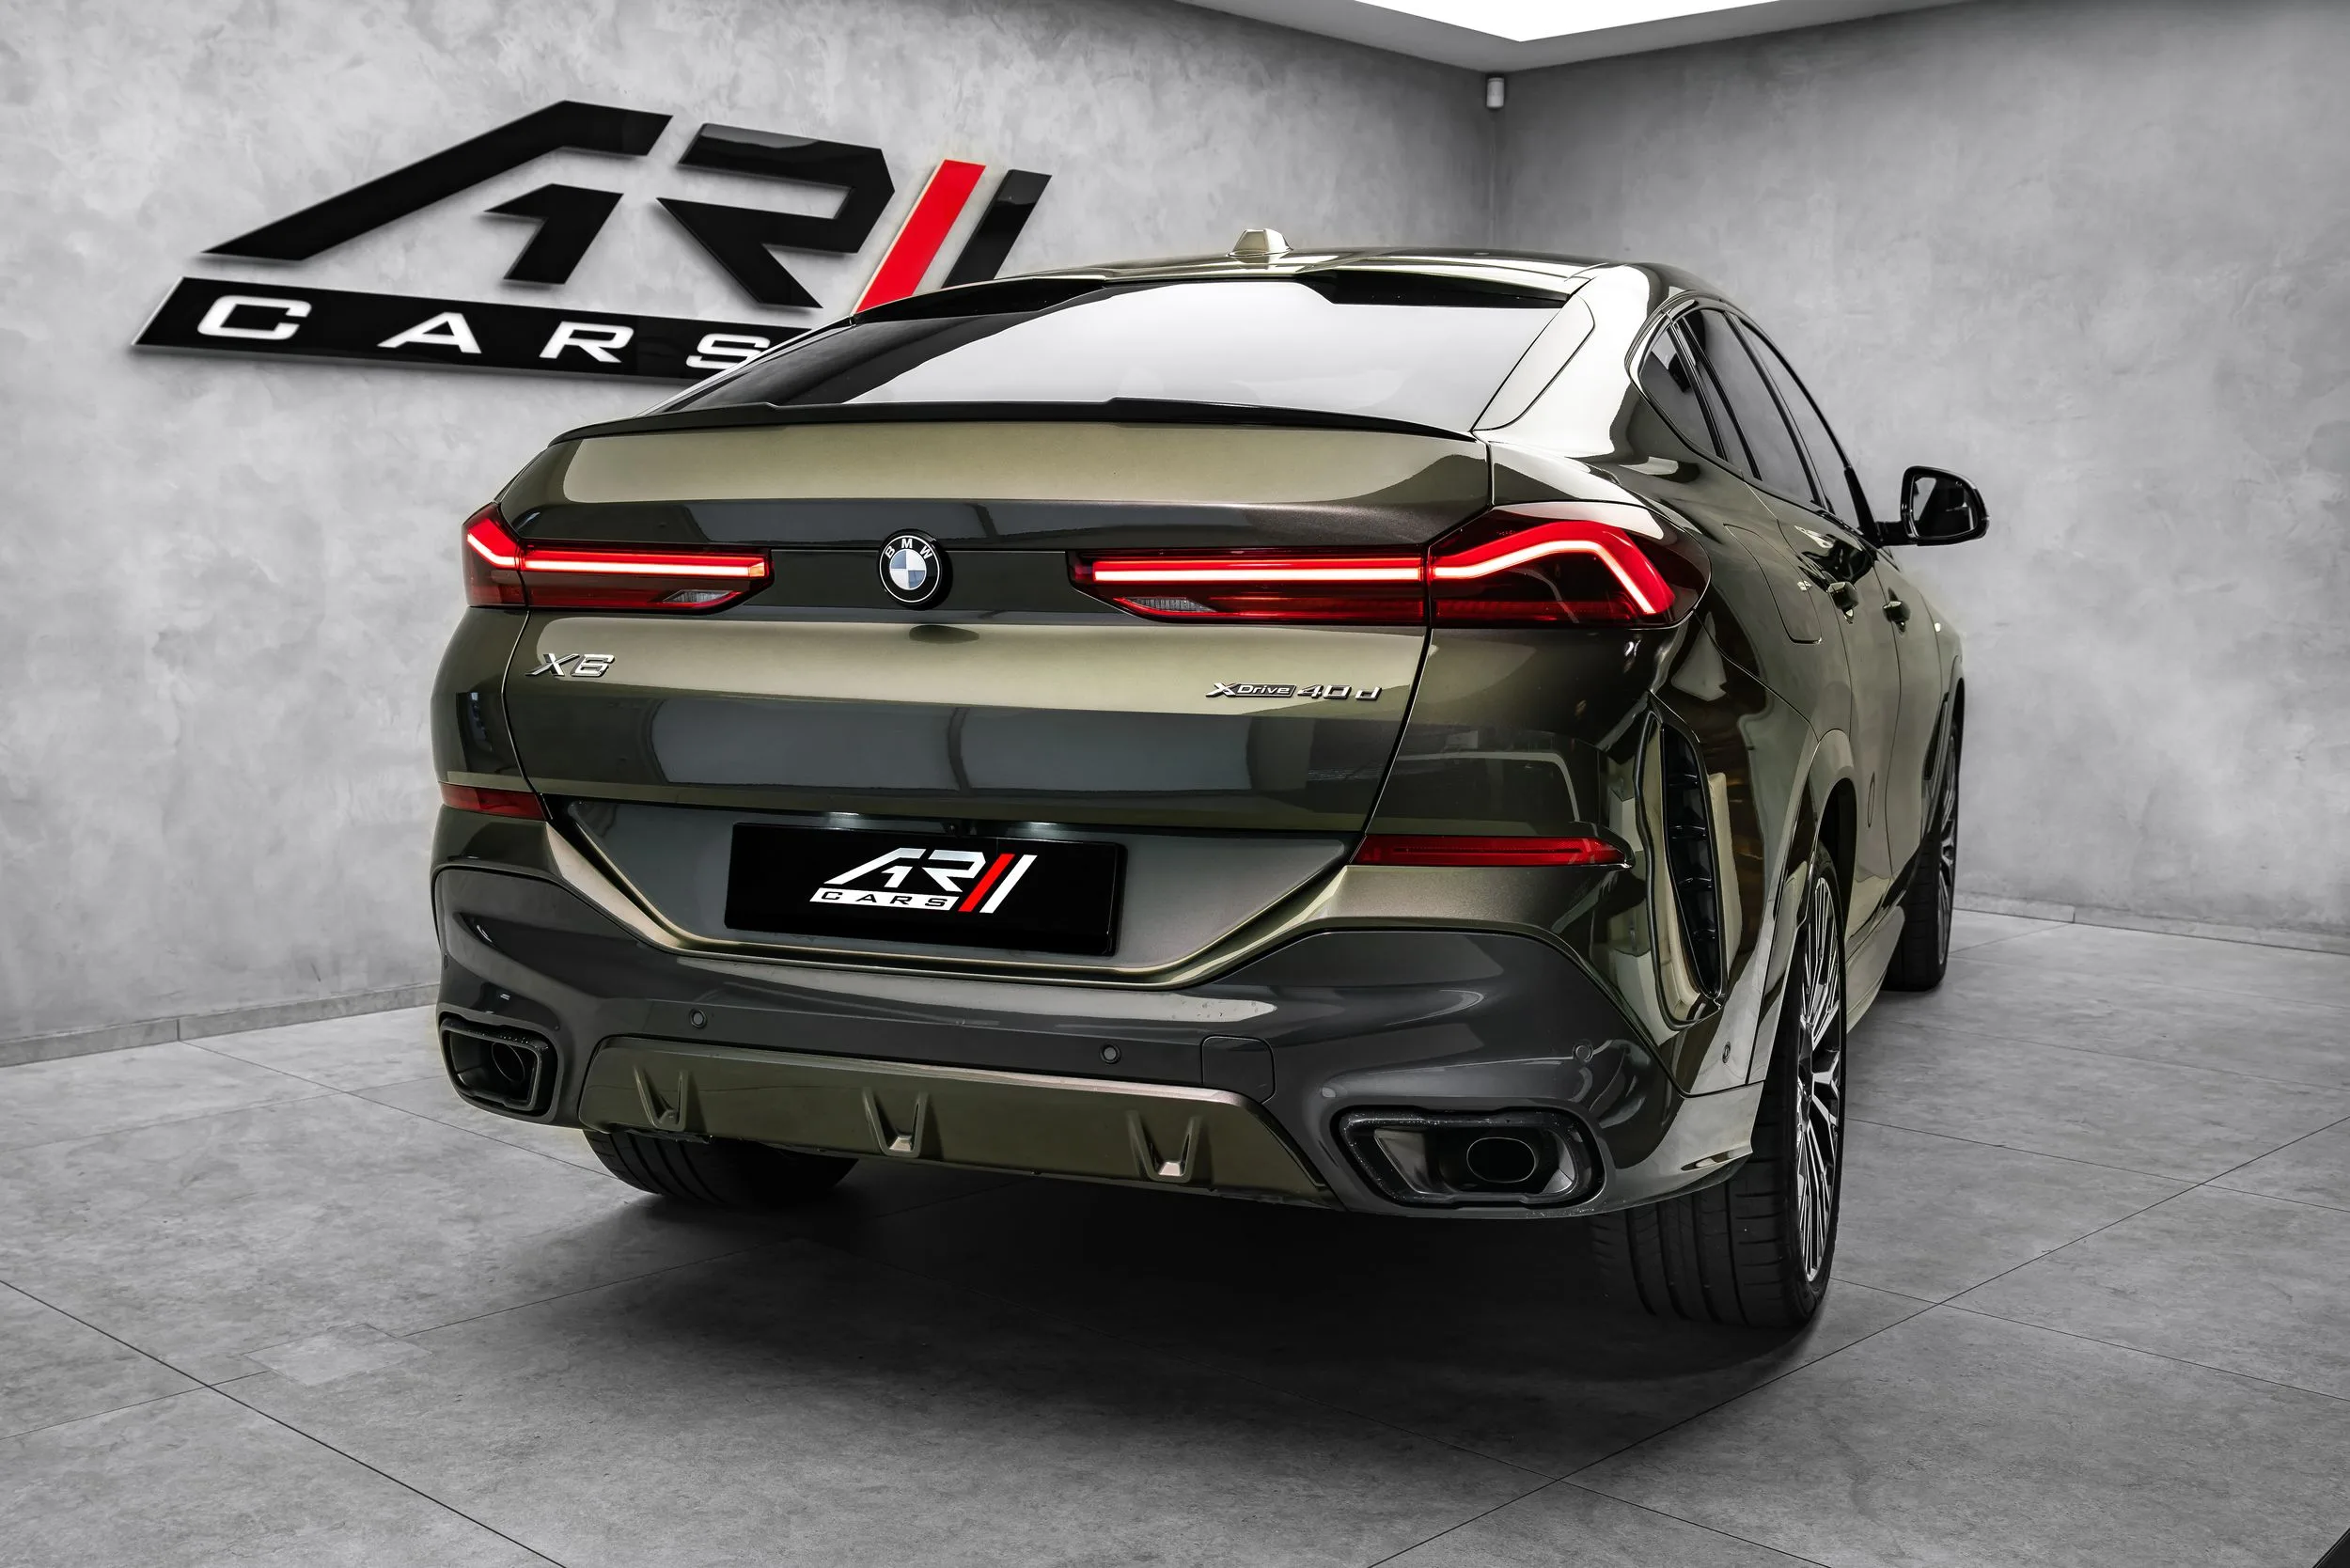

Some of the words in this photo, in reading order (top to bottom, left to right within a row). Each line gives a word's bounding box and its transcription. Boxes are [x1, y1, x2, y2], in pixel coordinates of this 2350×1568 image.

[196, 294, 771, 372] CARS
[884, 538, 933, 559] BMW
[525, 652, 616, 678] X6
[821, 891, 948, 907] CARS
